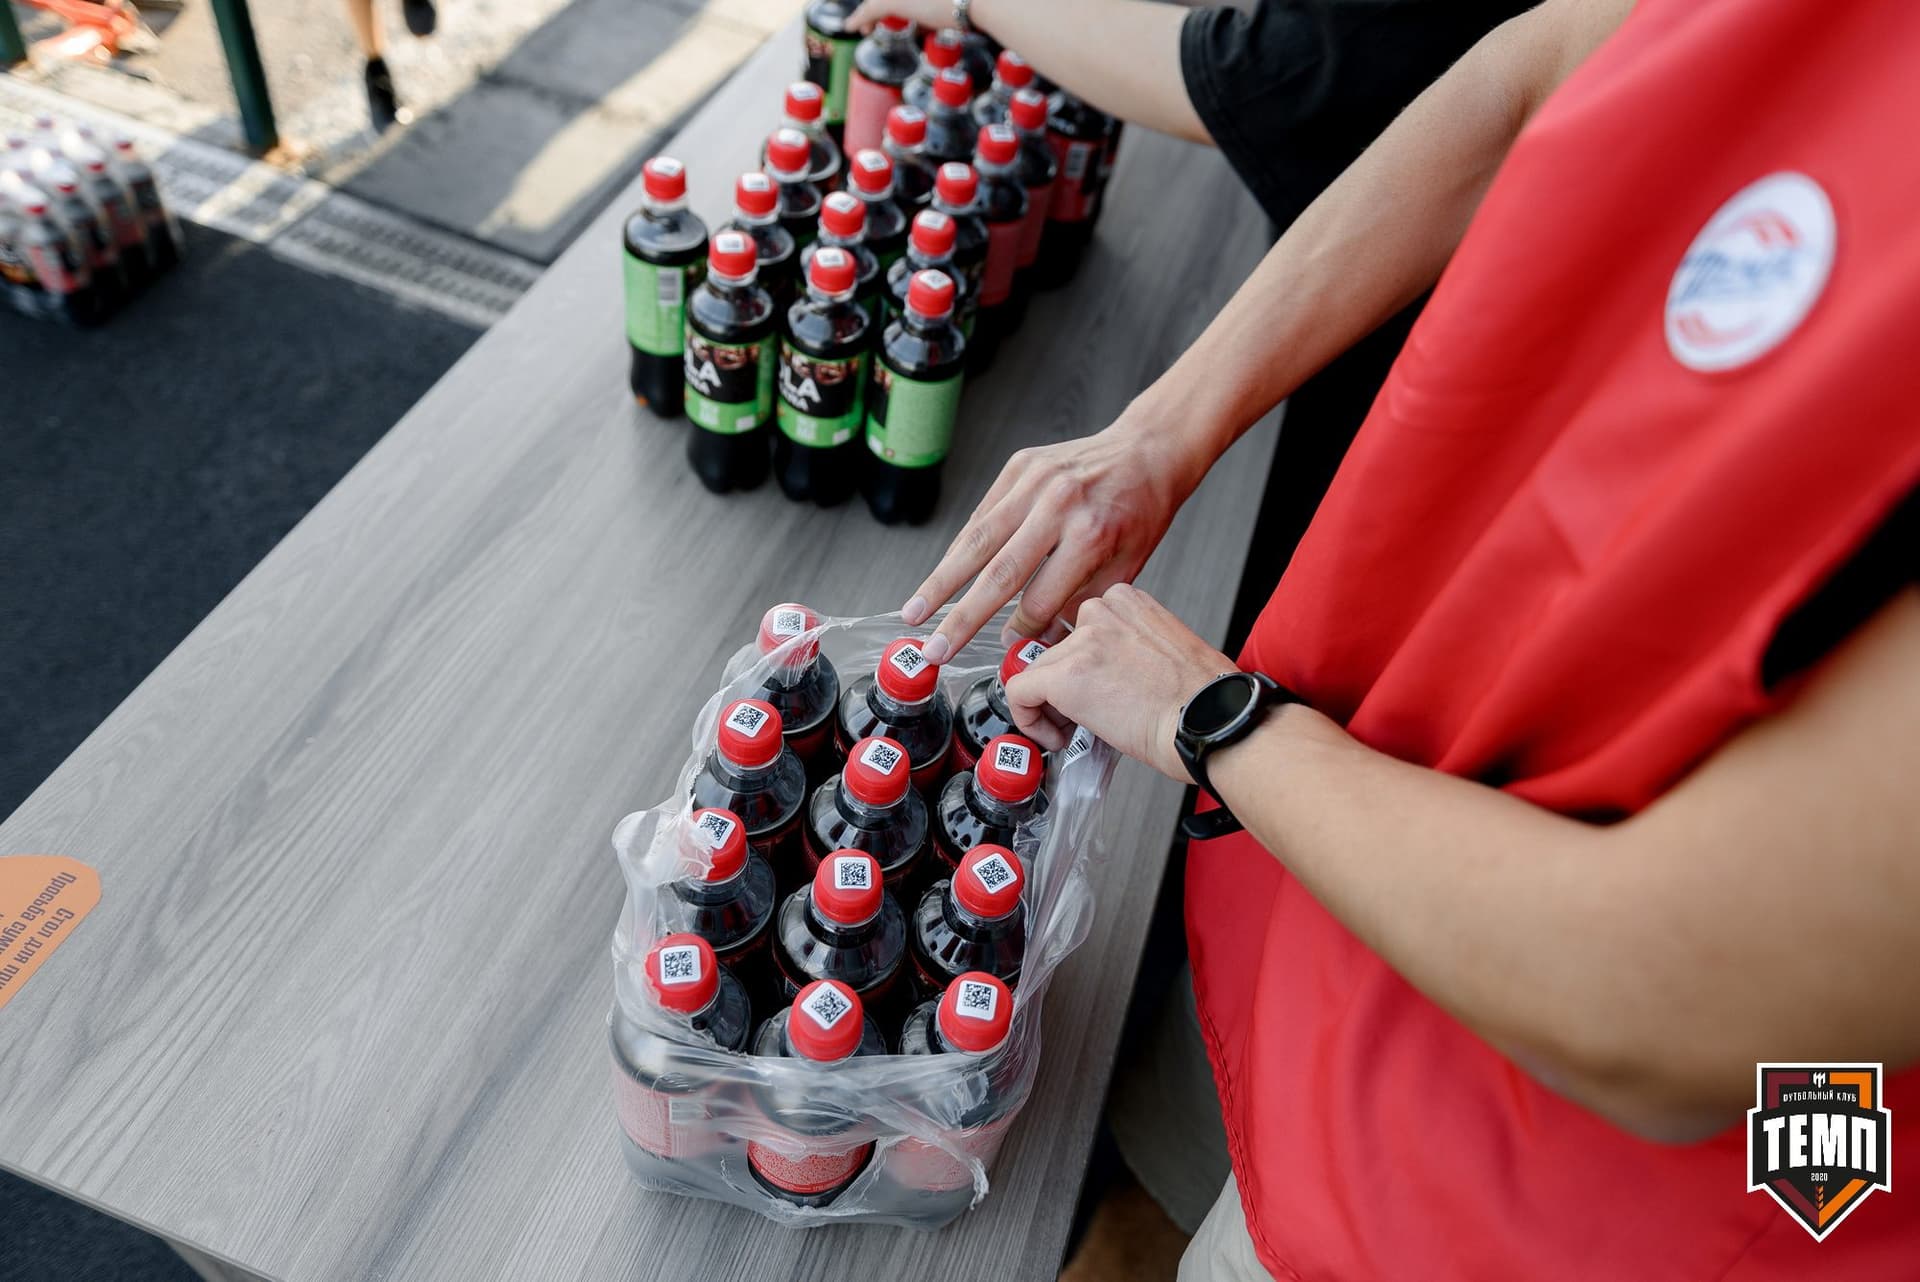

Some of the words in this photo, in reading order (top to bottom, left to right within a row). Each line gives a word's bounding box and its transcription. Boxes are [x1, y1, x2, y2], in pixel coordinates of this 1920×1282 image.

[20, 871, 78, 922] Просьба
[37, 907, 75, 939] Стол
[13, 936, 43, 964] для
